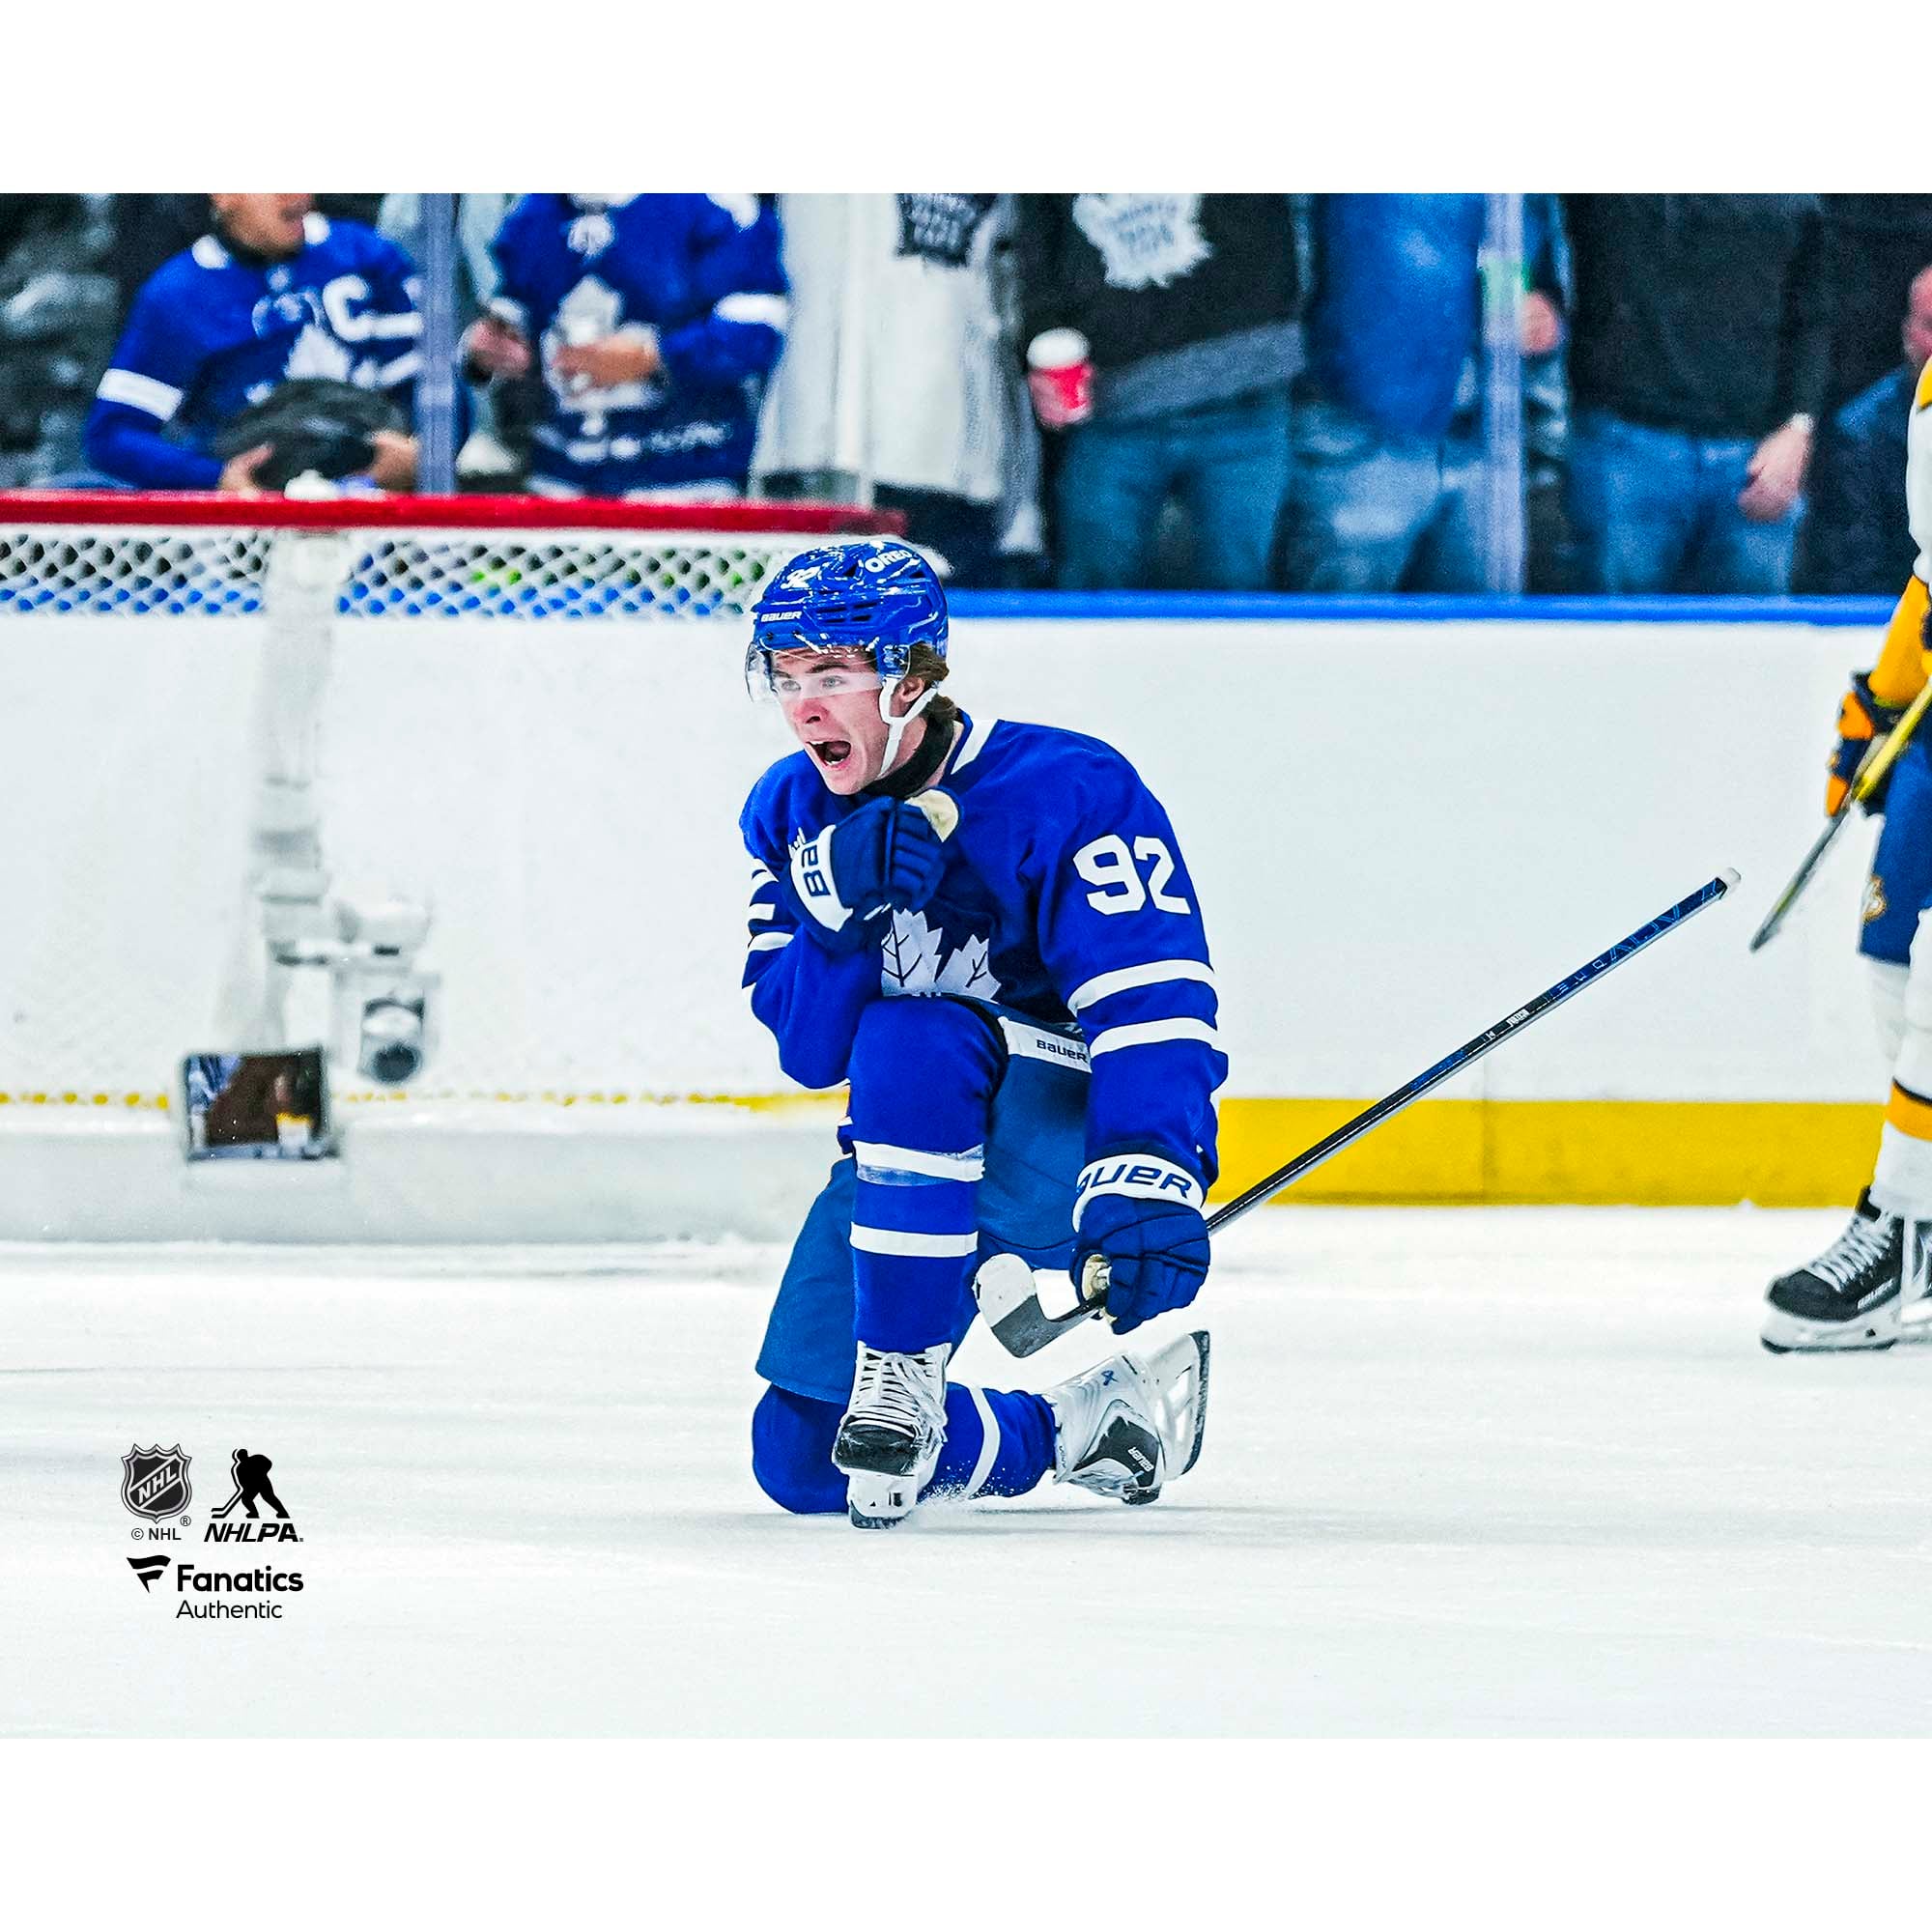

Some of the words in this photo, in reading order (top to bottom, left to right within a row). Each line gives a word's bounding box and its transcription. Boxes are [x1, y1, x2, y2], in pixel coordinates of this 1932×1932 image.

[864, 549, 913, 573] OREO
[760, 611, 803, 623] BAUER
[1072, 834, 1191, 915] 92
[1037, 1039, 1088, 1063] BAUER
